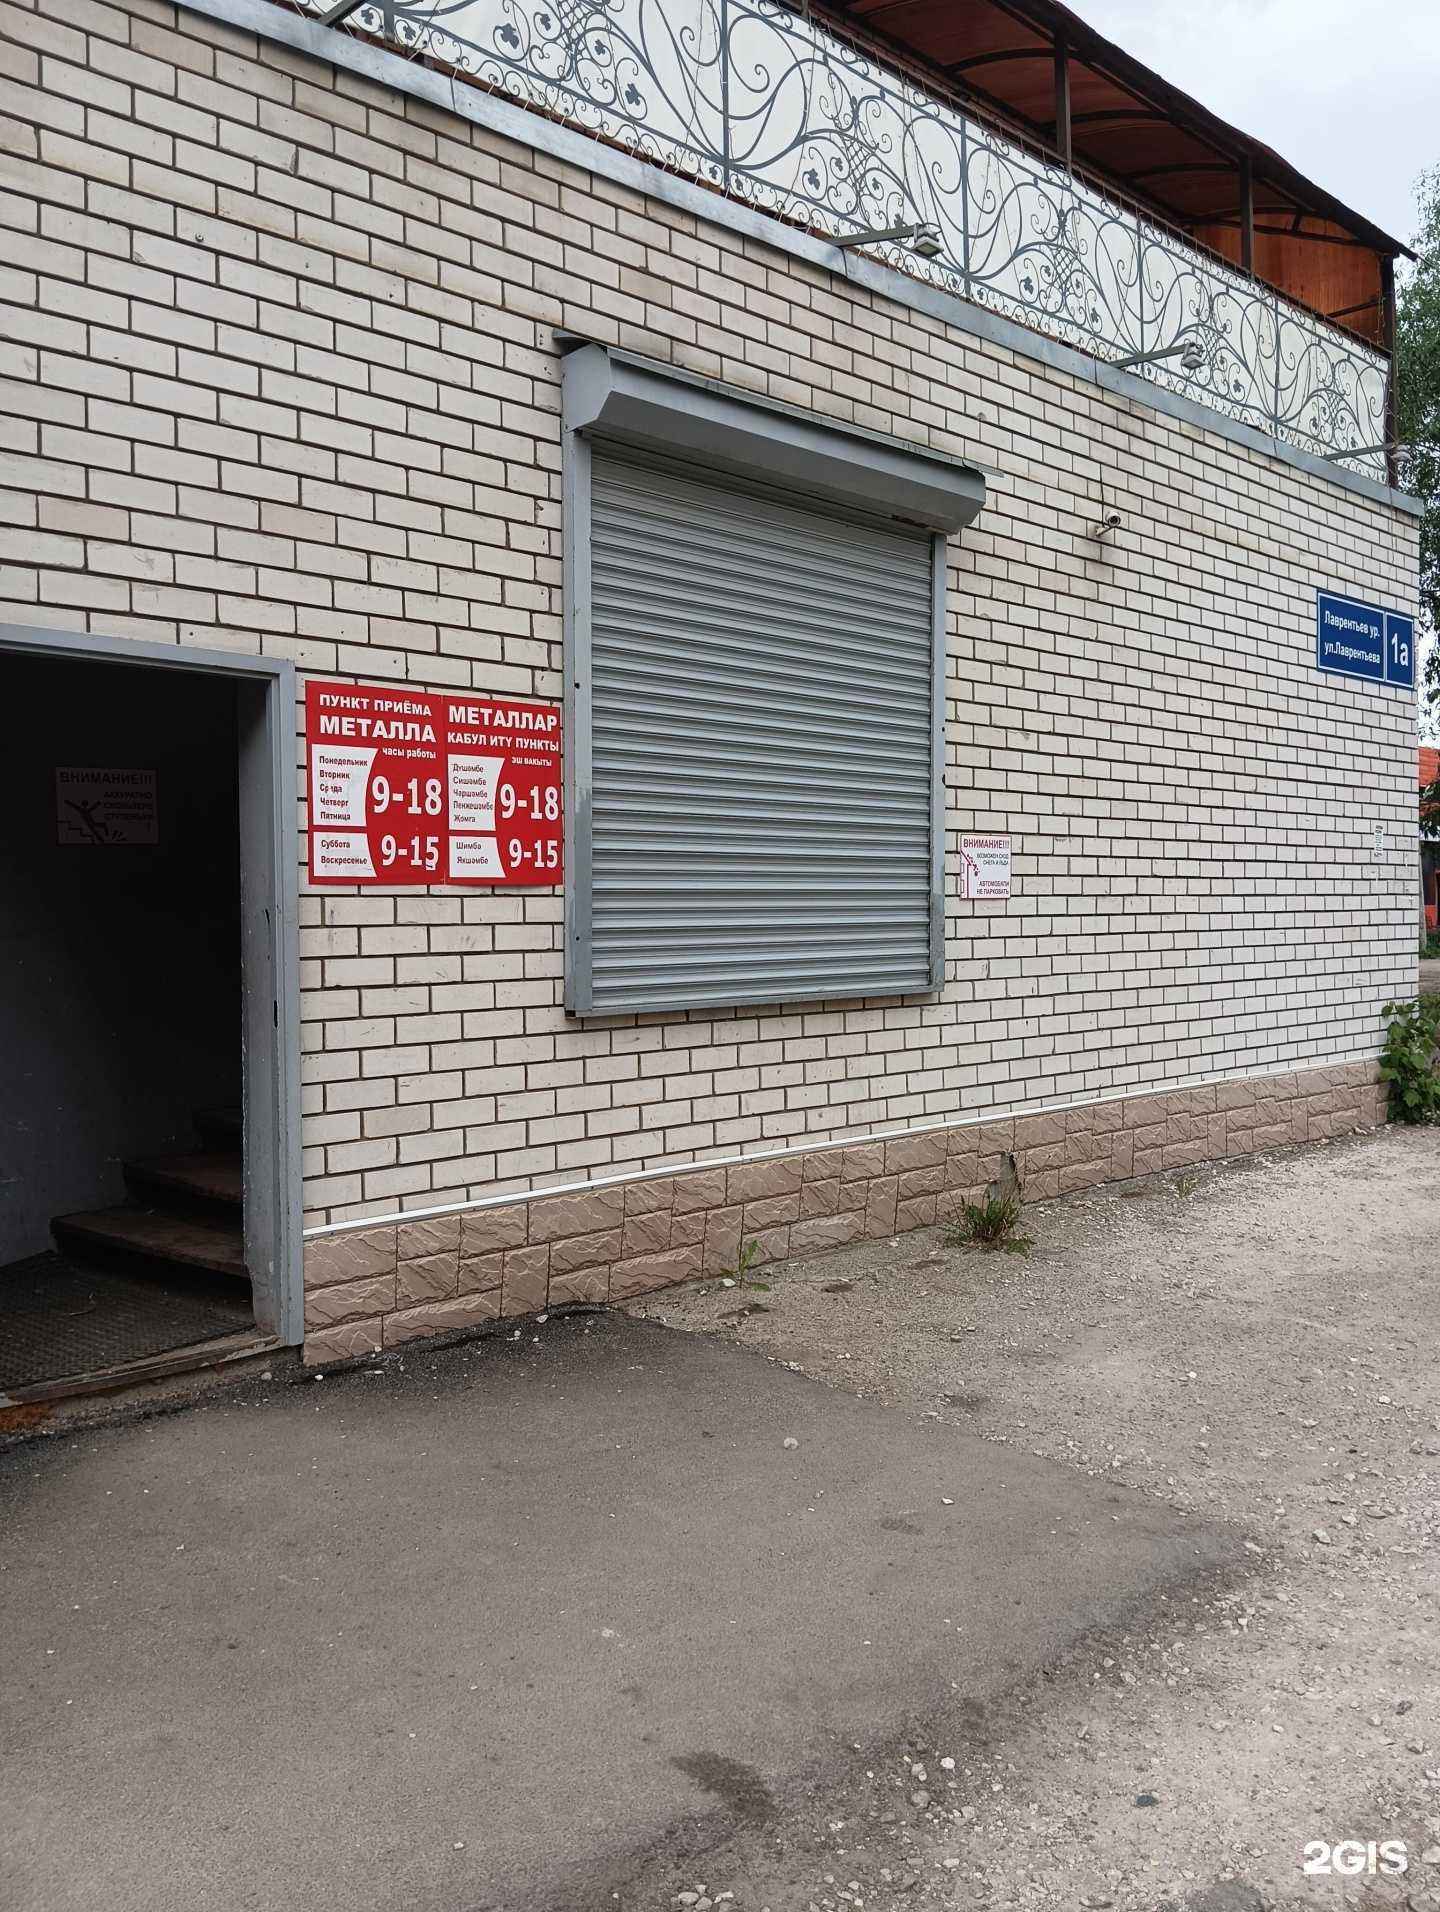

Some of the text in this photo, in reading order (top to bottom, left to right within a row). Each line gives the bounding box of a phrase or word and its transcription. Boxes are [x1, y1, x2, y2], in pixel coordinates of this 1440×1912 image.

[1324, 610, 1381, 639] Лаврентьев ур.
[1324, 641, 1381, 664] ул.Лаврентьева
[1391, 632, 1409, 667] 1а
[319, 693, 432, 717] ПУНКТ ПРИЁМА
[319, 715, 436, 742] МЕТАЛЛА
[448, 705, 558, 732] МЕТАЛЛАР
[382, 746, 437, 760] часы работы
[447, 731, 488, 747] КАБУЛ
[515, 737, 560, 753] ПУНКТЫ
[319, 755, 369, 768] Понедельник
[59, 771, 153, 785] ВНИМАНИЕ!!!
[319, 769, 351, 781] Вторник
[320, 797, 349, 808] Четверг
[371, 776, 443, 816] 9-18
[500, 783, 560, 822] 9-18
[320, 811, 351, 823] Пятница
[320, 839, 351, 851] Суббота
[381, 834, 440, 871] 9-15
[509, 838, 559, 869] 9-15
[320, 855, 368, 867] Воскресенье
